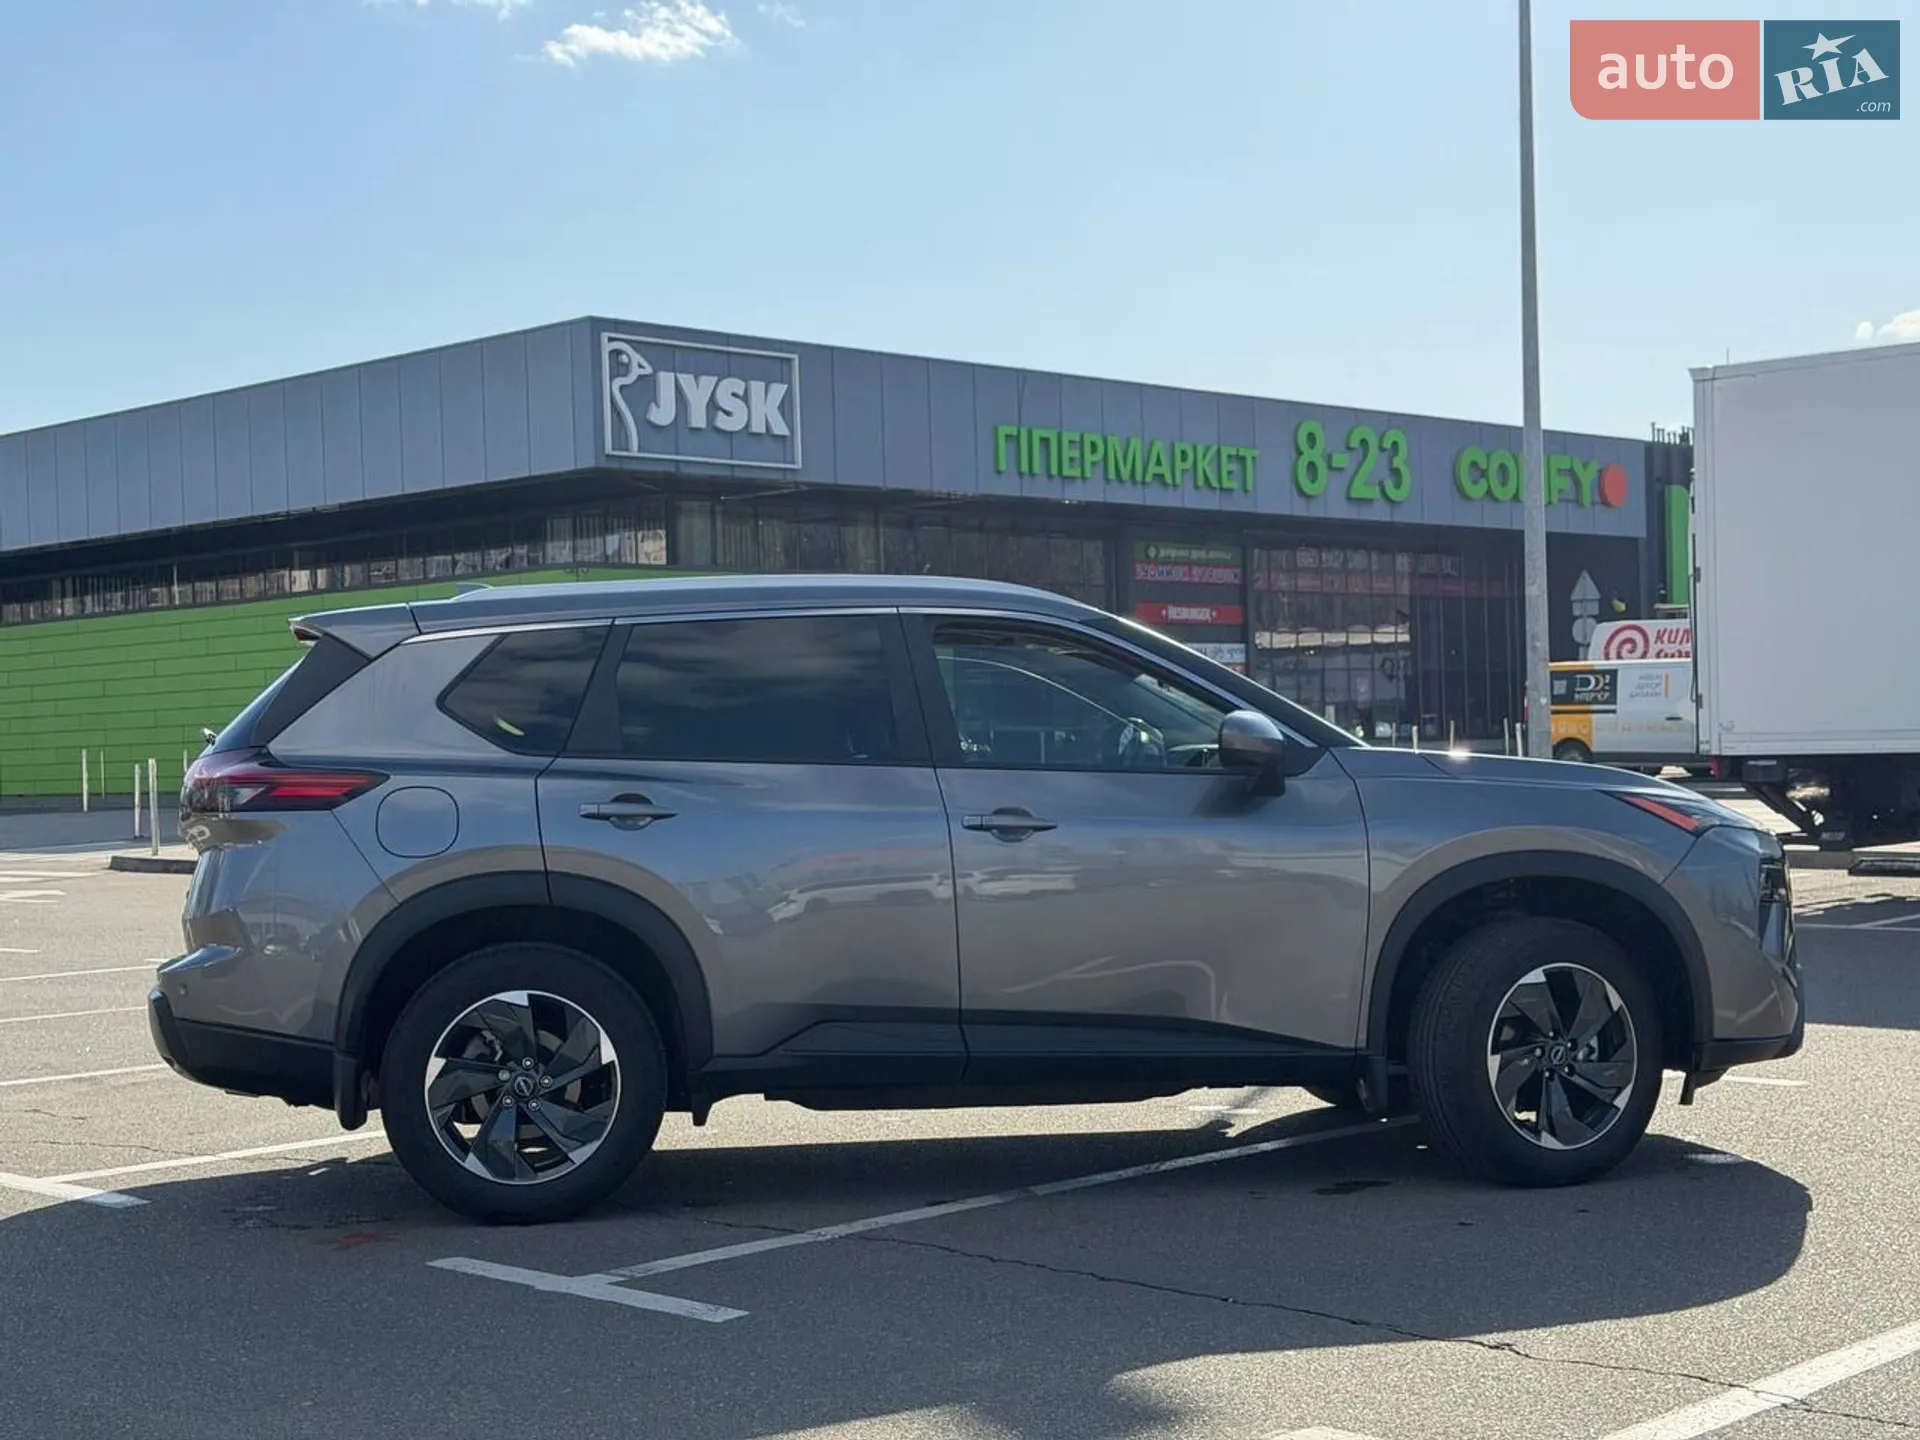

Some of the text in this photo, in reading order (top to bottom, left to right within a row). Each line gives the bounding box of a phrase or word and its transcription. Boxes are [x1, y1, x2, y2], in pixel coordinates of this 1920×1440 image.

[646, 371, 790, 437] JYSK
[995, 420, 1412, 502] ГІПЕРМАРКЕТ 8-23
[1455, 446, 1600, 508] COFY
[1654, 627, 1692, 645] КИЛ
